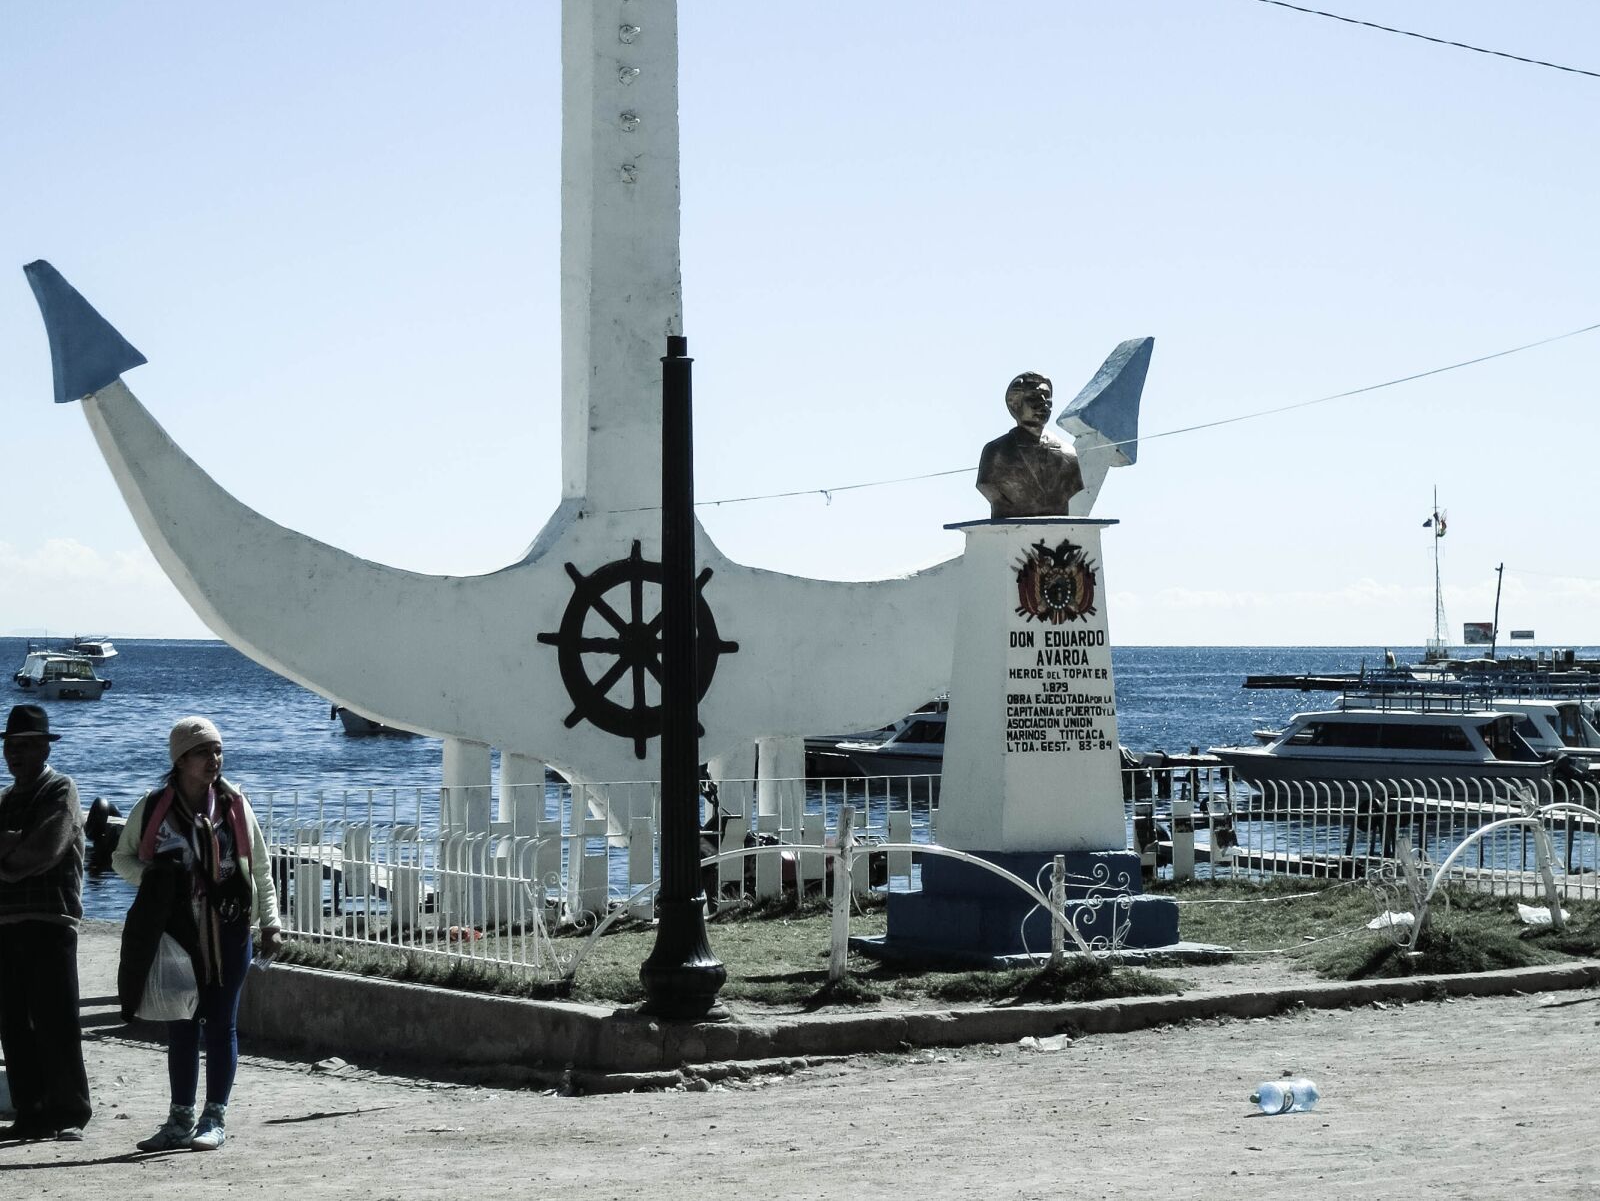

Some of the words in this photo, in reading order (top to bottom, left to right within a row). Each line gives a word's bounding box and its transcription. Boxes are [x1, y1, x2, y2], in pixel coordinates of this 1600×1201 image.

[1010, 631, 1034, 648] DON
[1045, 630, 1104, 647] EDUARDO
[1036, 649, 1089, 666] AVAROA
[1009, 668, 1044, 679] HEROE
[1046, 671, 1061, 680] DEL
[1063, 668, 1107, 680] TOPATER
[1007, 694, 1032, 704] OBRA
[1035, 694, 1090, 704] EJECUTADA
[1104, 695, 1112, 704] LA
[1007, 707, 1055, 717] CAPITANIA
[1065, 706, 1102, 716] PUERTO
[1007, 718, 1060, 729] ASOCIACION
[1063, 718, 1093, 728] UNION
[1006, 730, 1047, 741] MARINOS
[1059, 729, 1105, 740] TITICACA
[1007, 742, 1039, 752] LTDA.
[1041, 741, 1071, 752] GEST.
[1079, 740, 1112, 751] 83-84
